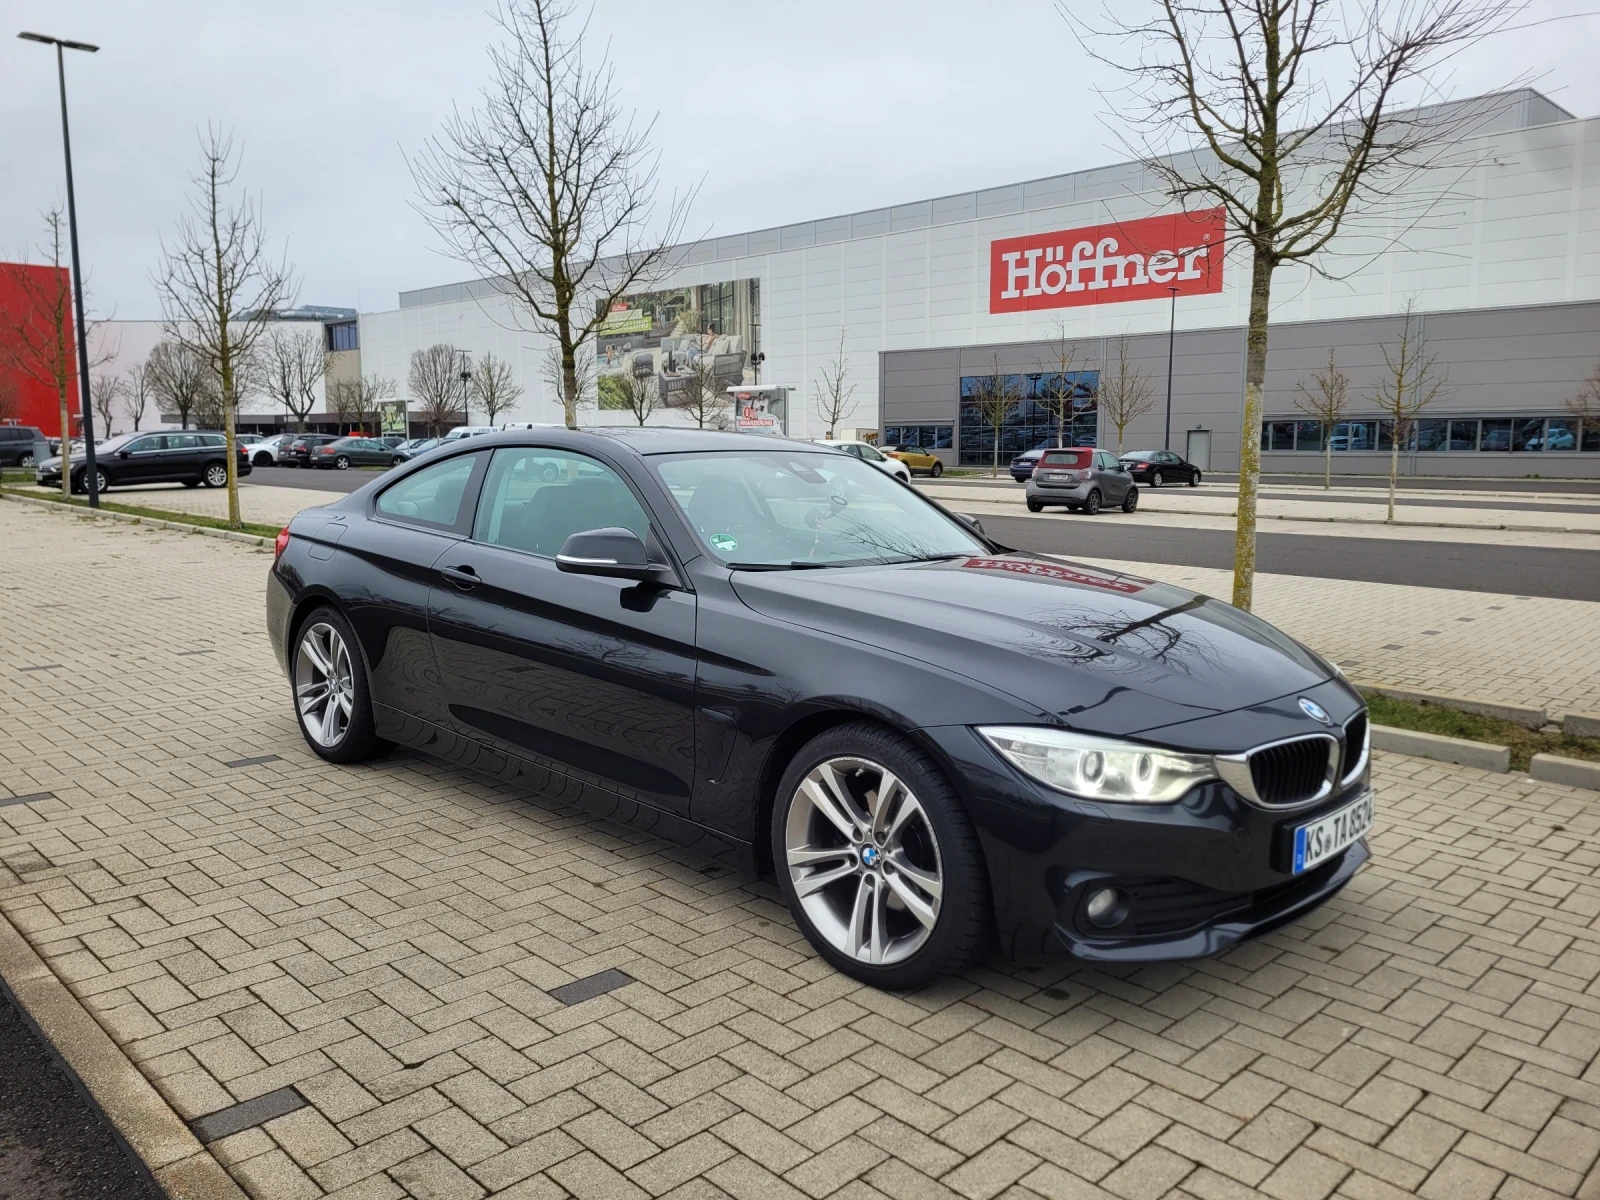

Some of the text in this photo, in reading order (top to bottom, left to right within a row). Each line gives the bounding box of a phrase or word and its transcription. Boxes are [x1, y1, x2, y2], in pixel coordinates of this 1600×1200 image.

[1001, 237, 1210, 299] Höffner
[1306, 826, 1324, 862] KS
[1334, 813, 1347, 848] TA
